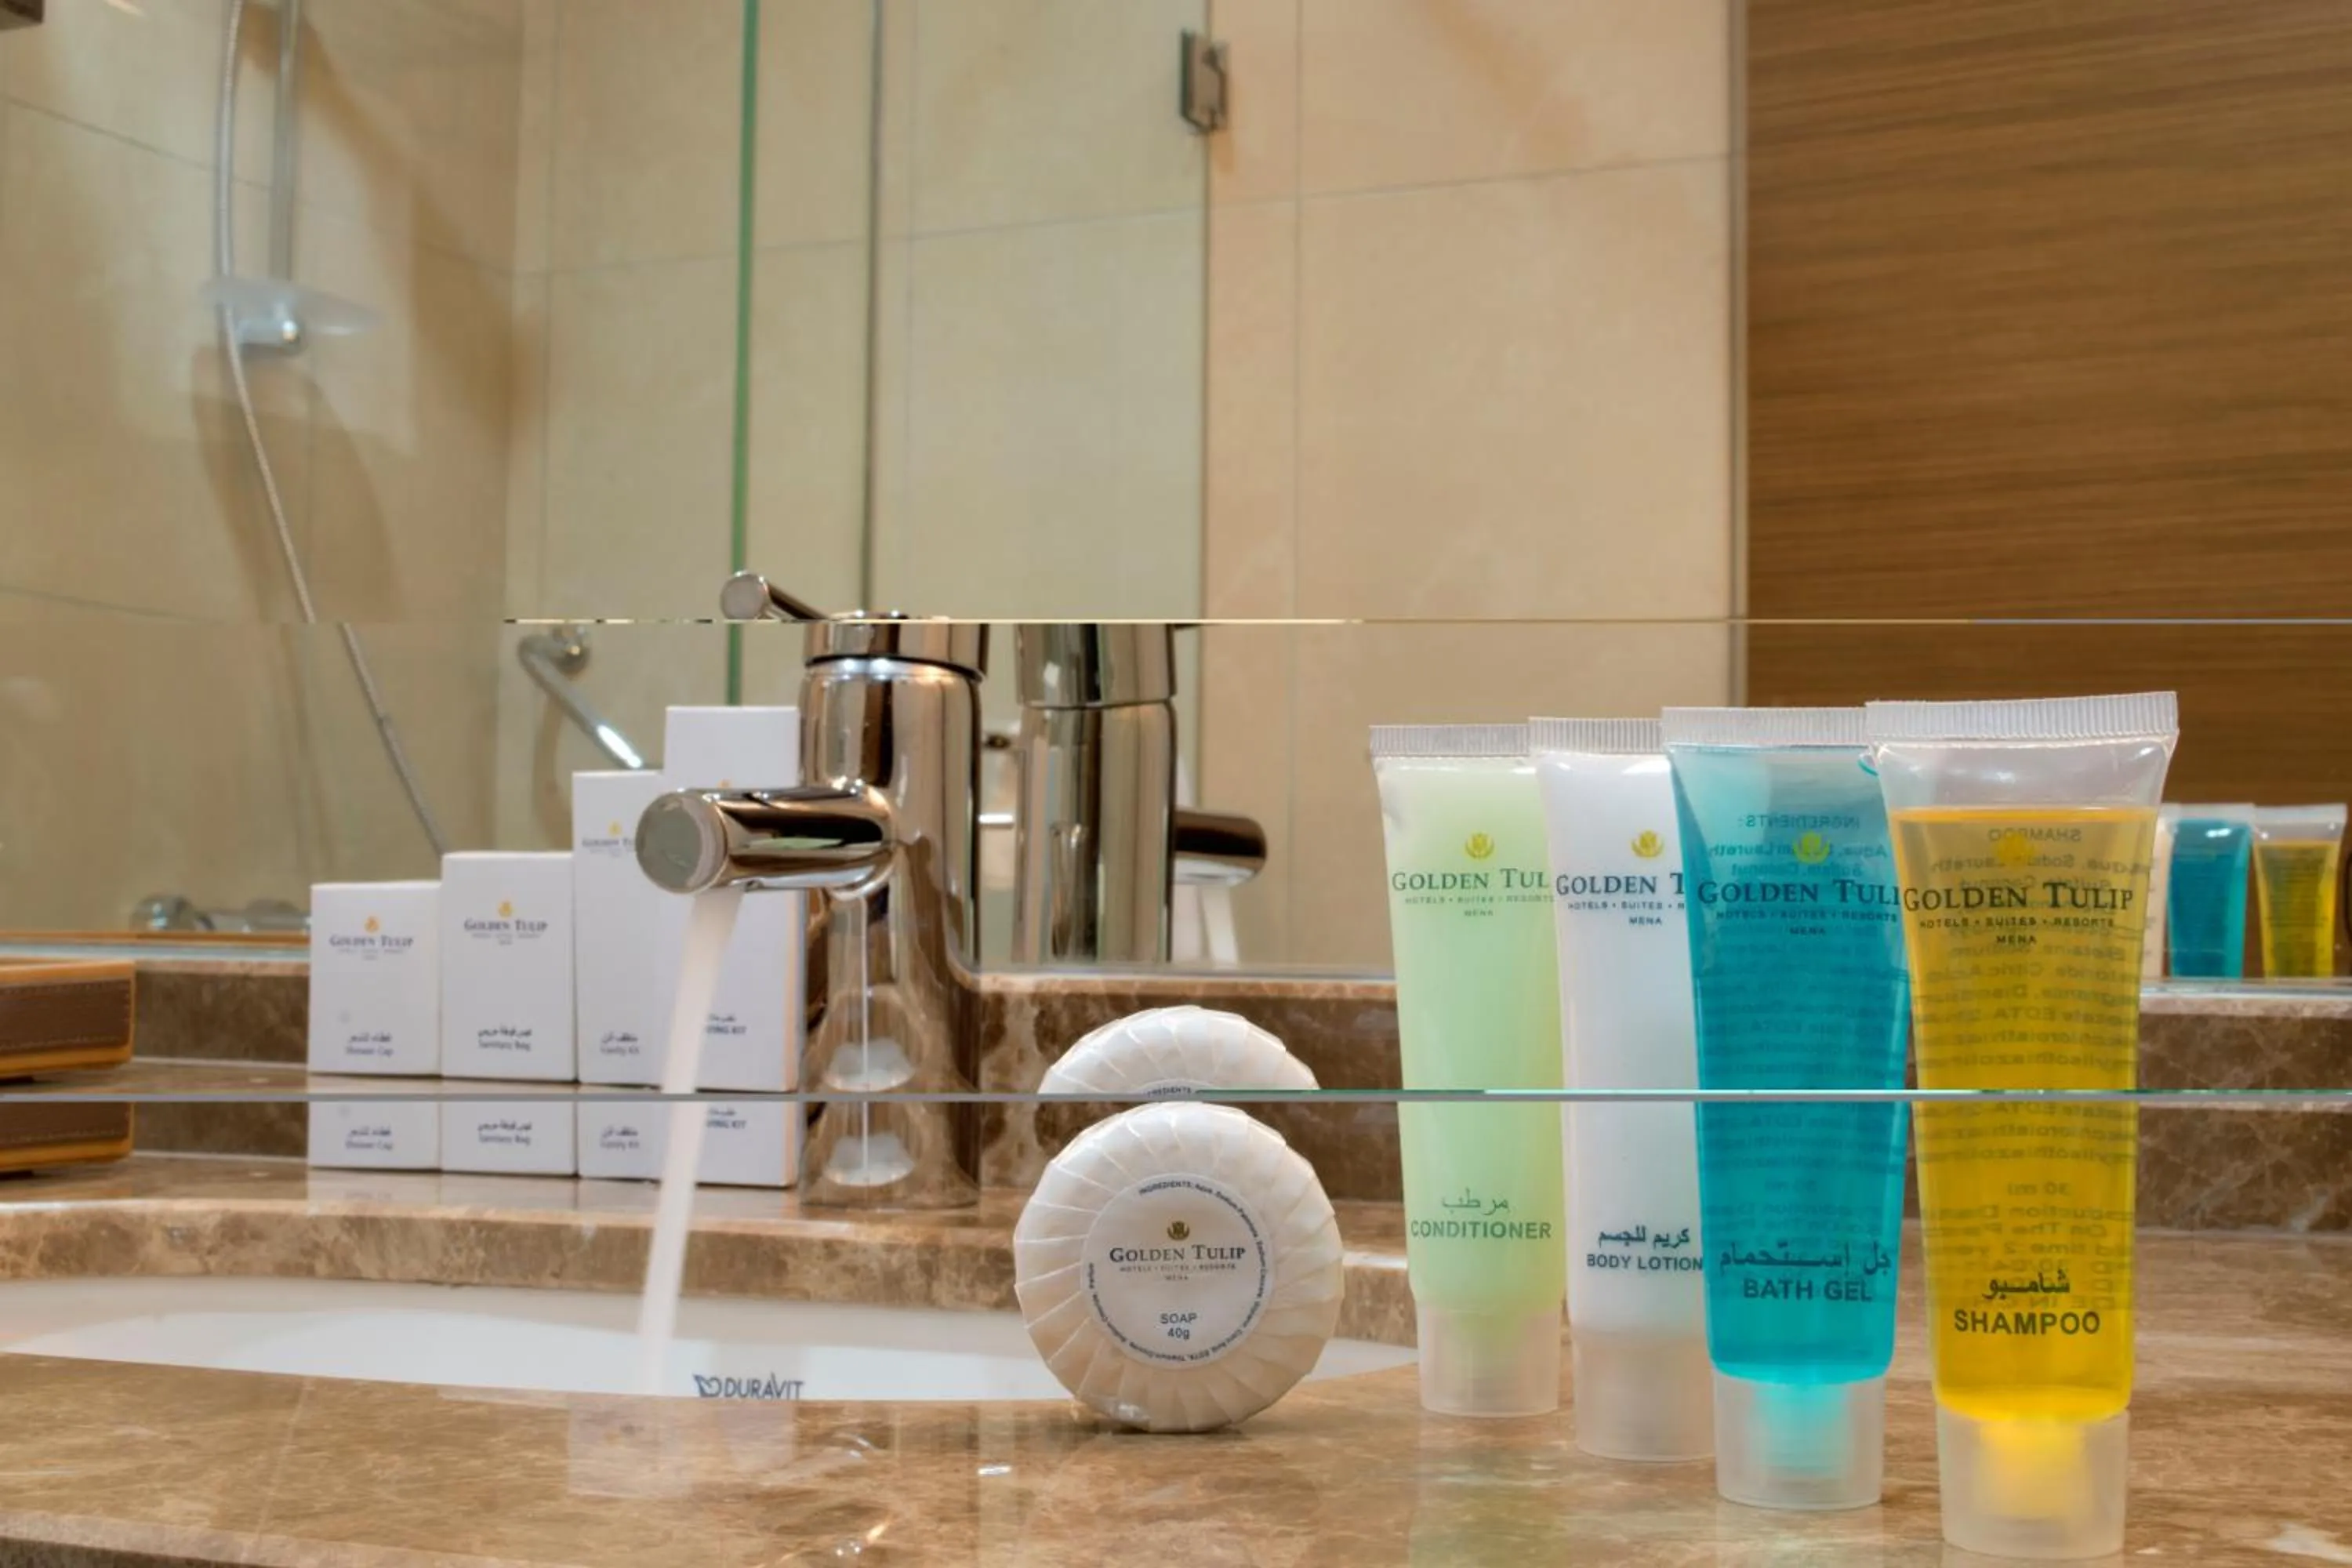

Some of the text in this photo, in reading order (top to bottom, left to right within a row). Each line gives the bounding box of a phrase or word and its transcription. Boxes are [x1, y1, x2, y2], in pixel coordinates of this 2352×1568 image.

[1392, 867, 1550, 891] GOLDEN TUL
[1555, 873, 1657, 895] GOLDEN
[1405, 896, 1446, 905] HOTELS
[1457, 895, 1494, 904] SUITES
[1697, 880, 1820, 905] GOLDEN
[1831, 879, 1900, 906] TULI
[1903, 886, 2029, 912] GOLDEN
[2042, 881, 2134, 911] TULIP
[1568, 900, 1664, 910] HOTELS SUITES
[463, 917, 549, 933] GOLDEN TULIP
[1628, 916, 1663, 926] MENA
[1919, 916, 2115, 930] HOTELS SUITES RESORTS
[329, 934, 414, 948] GOLDEN TULIP
[1995, 935, 2038, 946] MENA
[1410, 1219, 1553, 1240] CONDITIONER
[1653, 1227, 1691, 1250] كريم
[1109, 1243, 1247, 1263] GOLDEN TULIP
[1586, 1253, 1704, 1272] BODY LOTION
[1743, 1278, 1873, 1303] BATH GEL
[1981, 1268, 2071, 1301] شامبو
[1159, 1312, 1199, 1325] SOAP
[1953, 1308, 2101, 1336] SHAMPOO
[1167, 1326, 1191, 1341] 40g
[724, 1371, 805, 1401] DURAVIT
